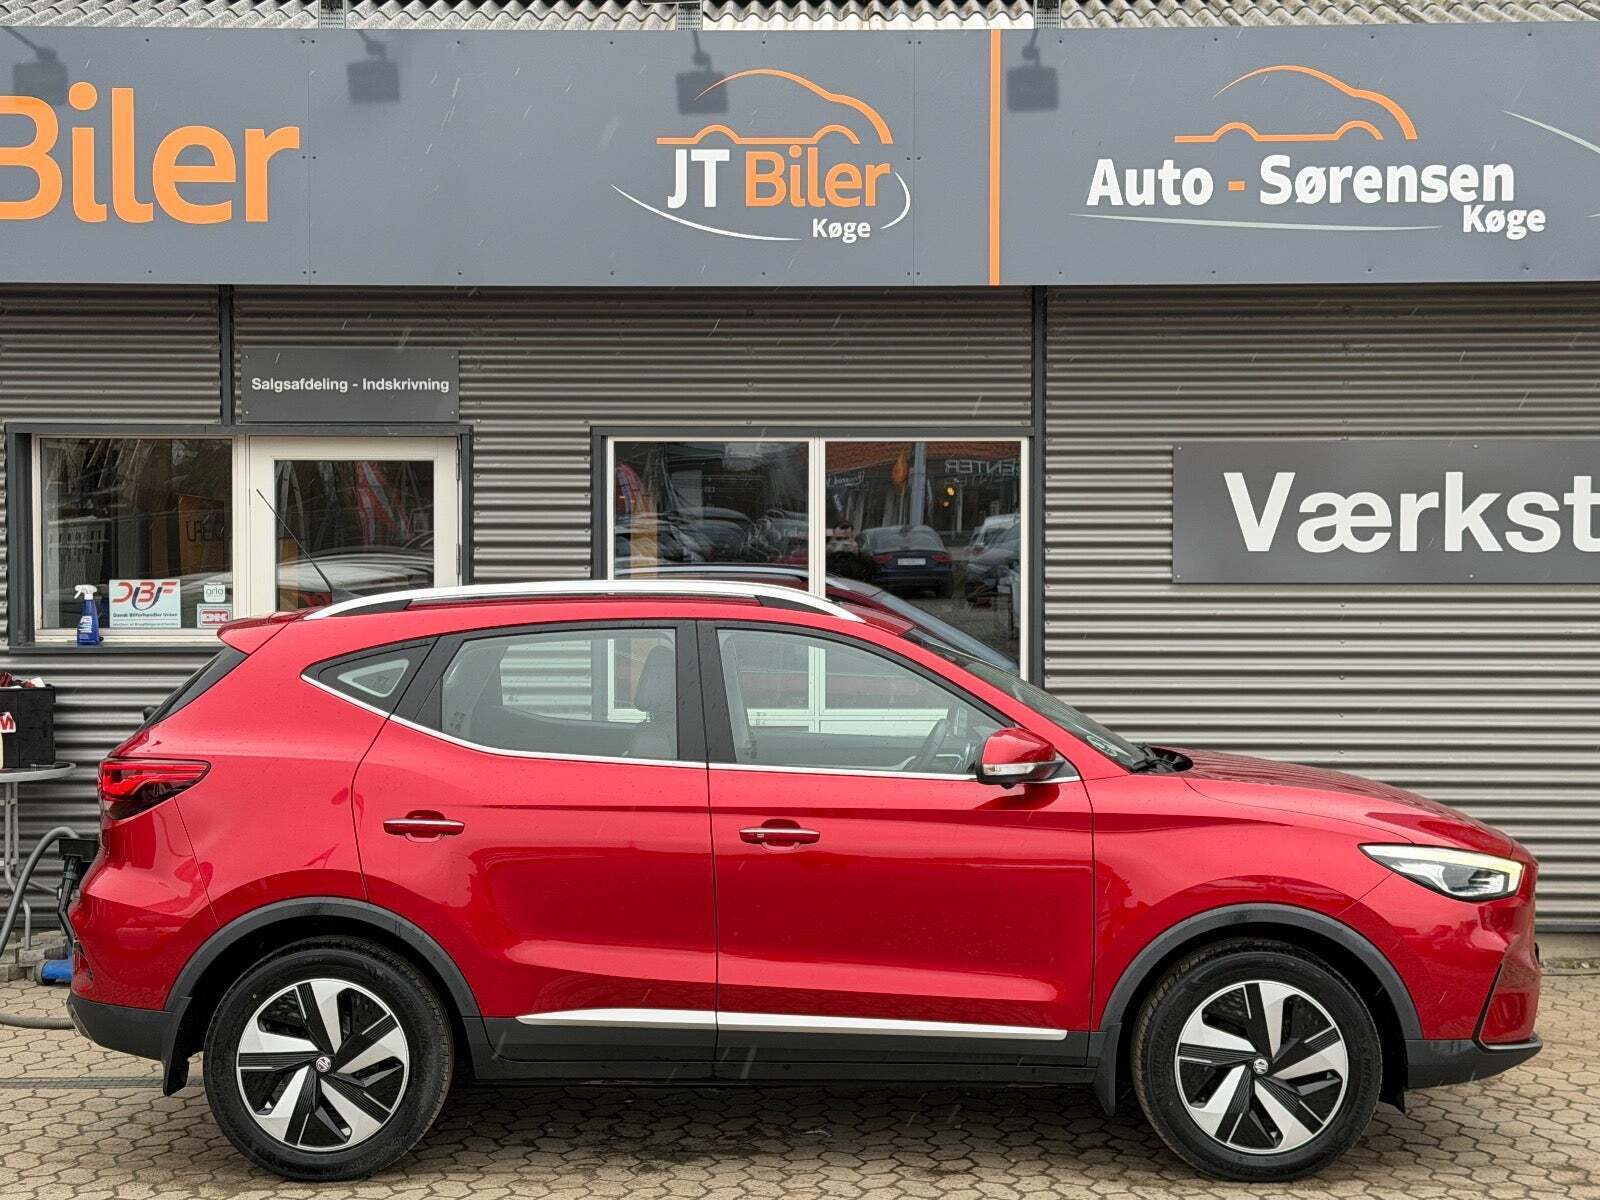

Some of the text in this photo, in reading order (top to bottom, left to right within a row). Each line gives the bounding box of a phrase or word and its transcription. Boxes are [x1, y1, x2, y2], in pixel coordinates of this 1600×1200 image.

[0, 81, 300, 224] Biler
[667, 144, 891, 208] JT Biler
[1086, 158, 1214, 206] Auto
[1260, 154, 1515, 205] Sørensen
[812, 218, 871, 243] Køge
[1462, 204, 1546, 240] Køge
[251, 377, 348, 392] Salgsafdeling
[362, 377, 449, 392] Indskrivning
[1223, 471, 1600, 553] Værkst
